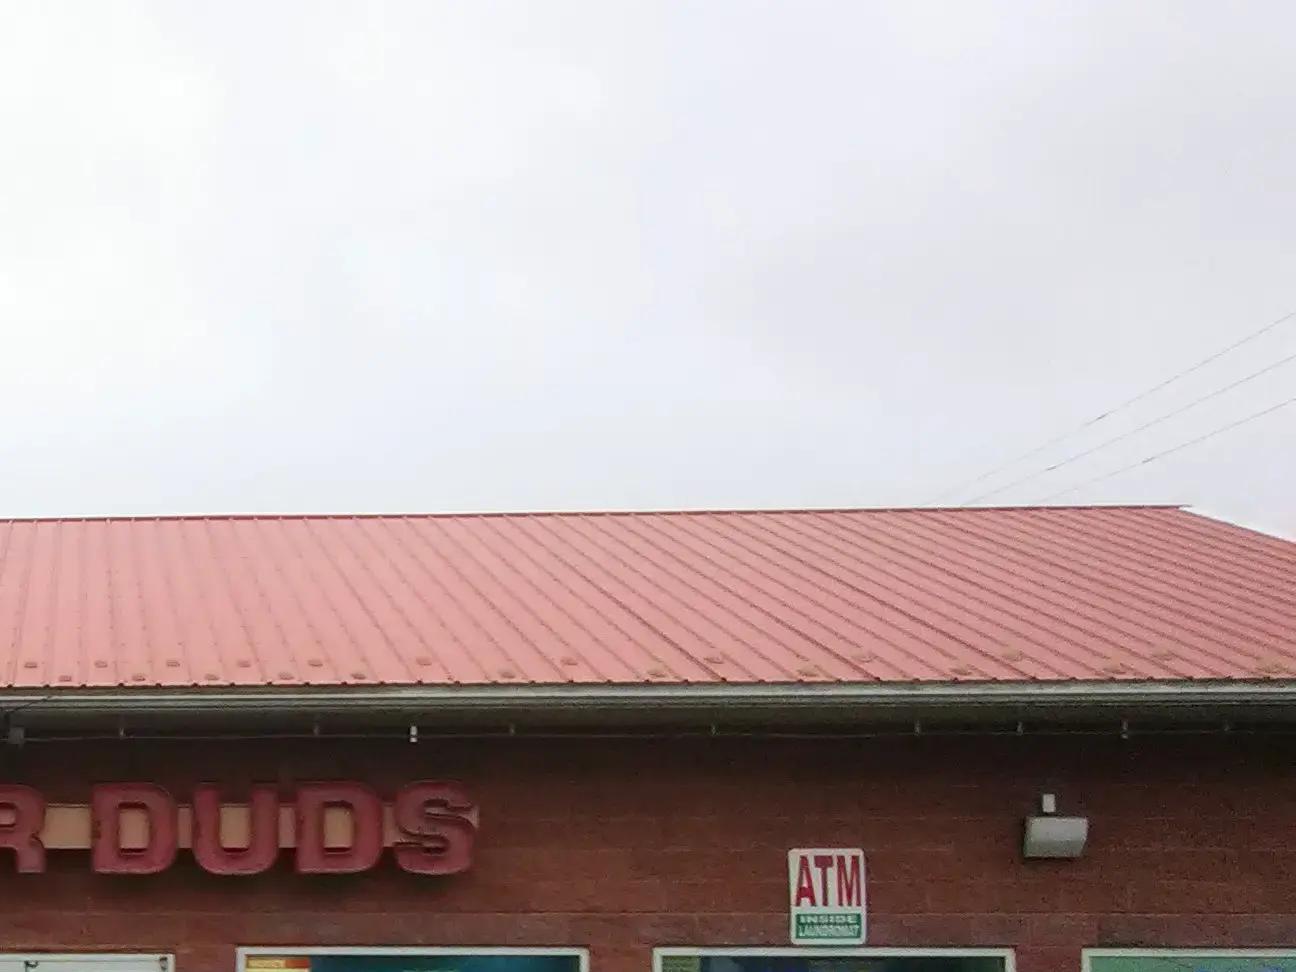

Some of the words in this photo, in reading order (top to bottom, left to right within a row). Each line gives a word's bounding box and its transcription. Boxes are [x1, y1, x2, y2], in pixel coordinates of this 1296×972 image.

[91, 781, 476, 876] DUDS
[795, 855, 862, 907] ATM
[799, 915, 858, 924] INSIDE
